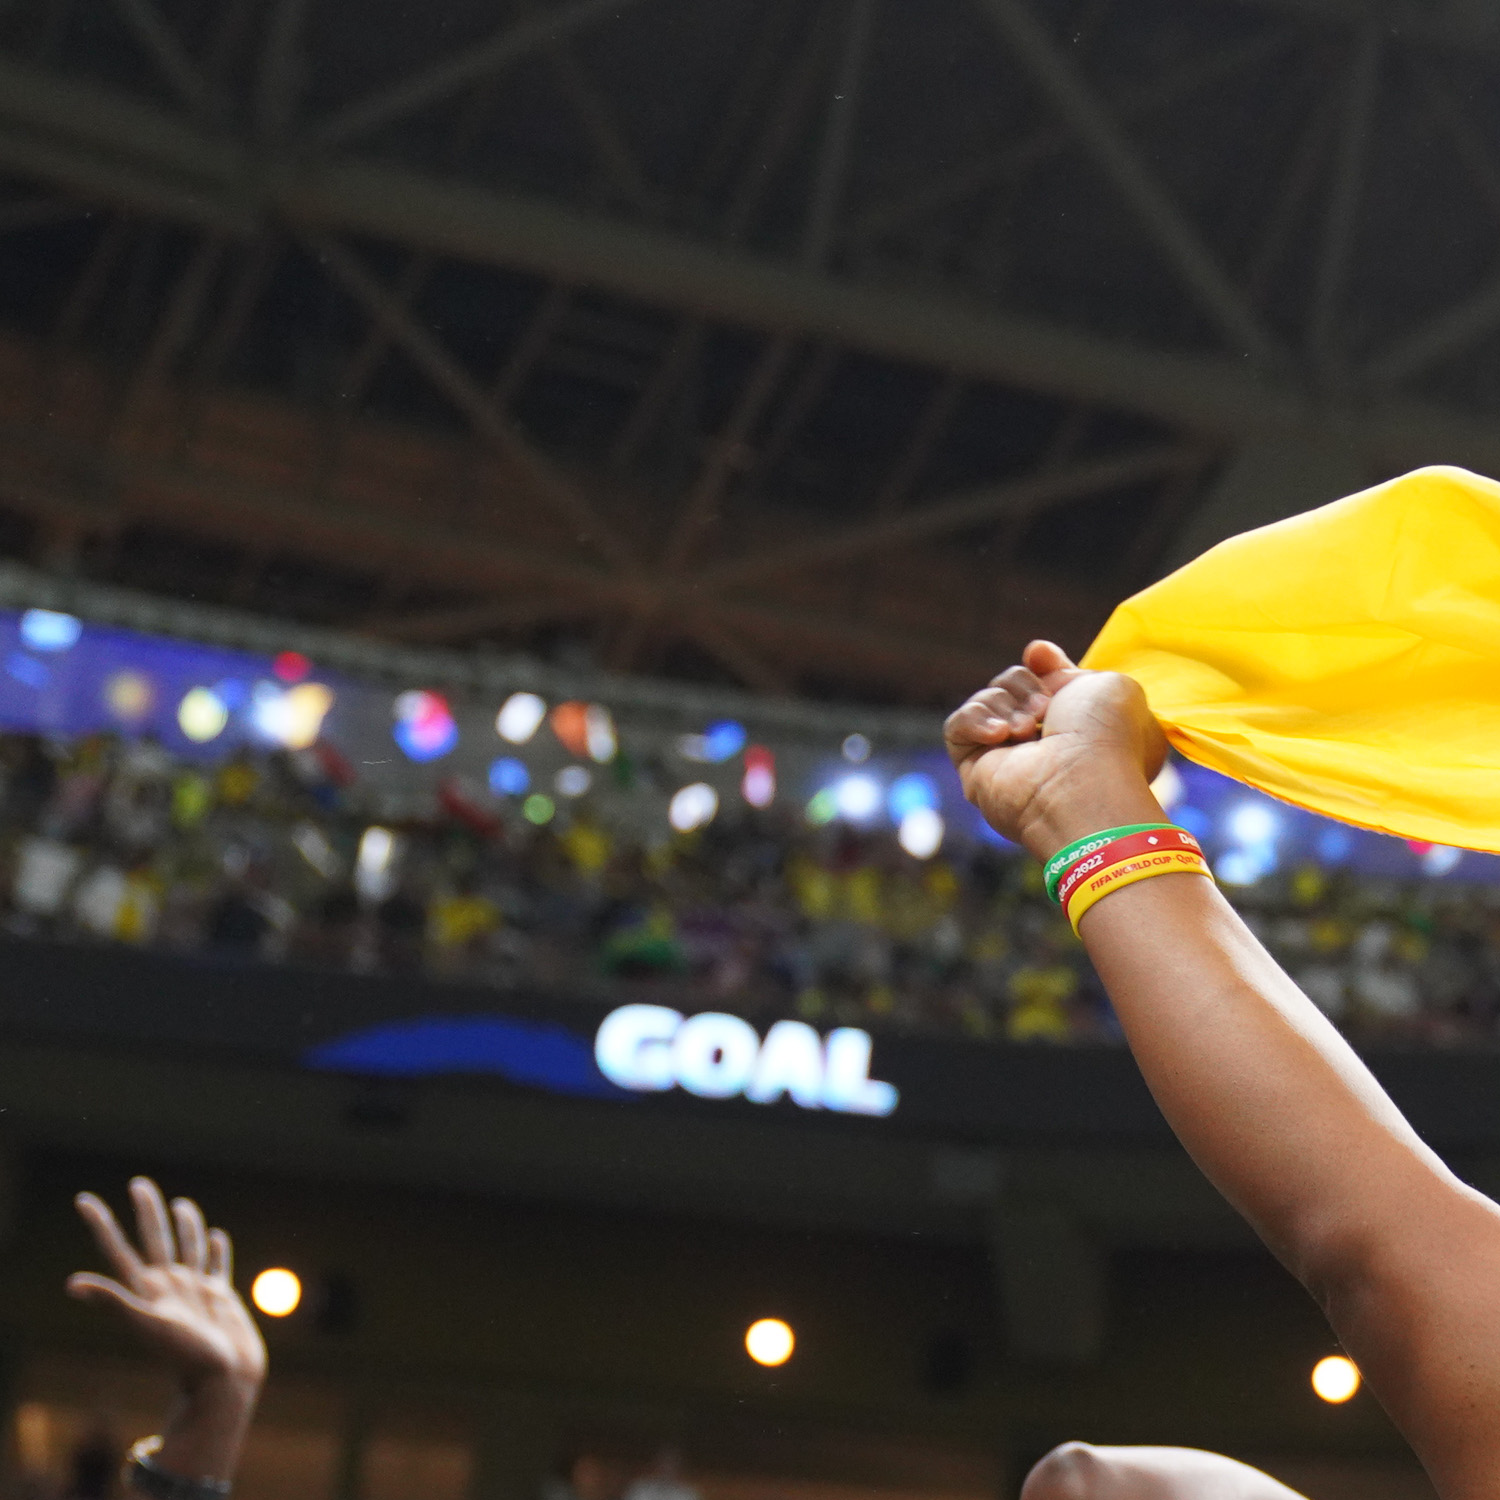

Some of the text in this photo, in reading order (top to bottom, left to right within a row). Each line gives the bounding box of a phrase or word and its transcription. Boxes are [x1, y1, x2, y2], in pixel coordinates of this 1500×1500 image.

[1090, 874, 1112, 892] FIFA
[1112, 860, 1152, 879] WORLD
[1152, 856, 1172, 866] CUP
[594, 1003, 899, 1117] GOAL
